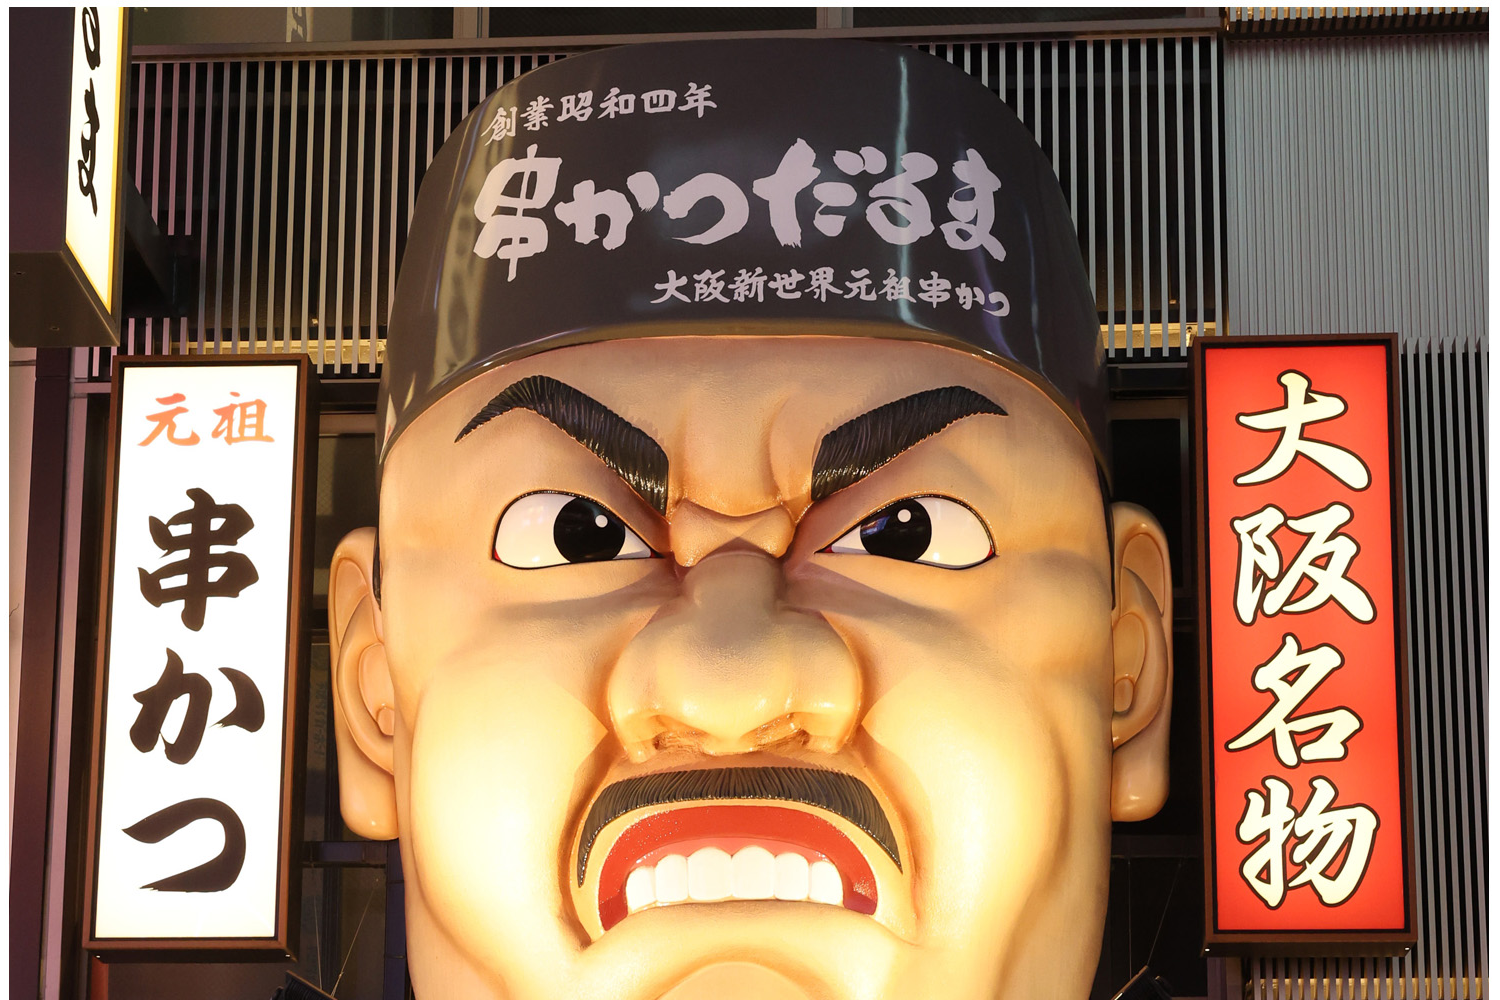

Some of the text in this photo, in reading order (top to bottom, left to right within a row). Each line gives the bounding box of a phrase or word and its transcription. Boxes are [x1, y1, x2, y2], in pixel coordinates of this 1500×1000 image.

[481, 82, 717, 146] 創業昭和四年
[473, 137, 1007, 282] 串かつだるま
[651, 266, 1010, 316] 大阪新世界元祖串かつ
[137, 391, 276, 447] 元祖
[122, 487, 266, 893] 串かつ
[1225, 369, 1379, 908] 大阪名物
